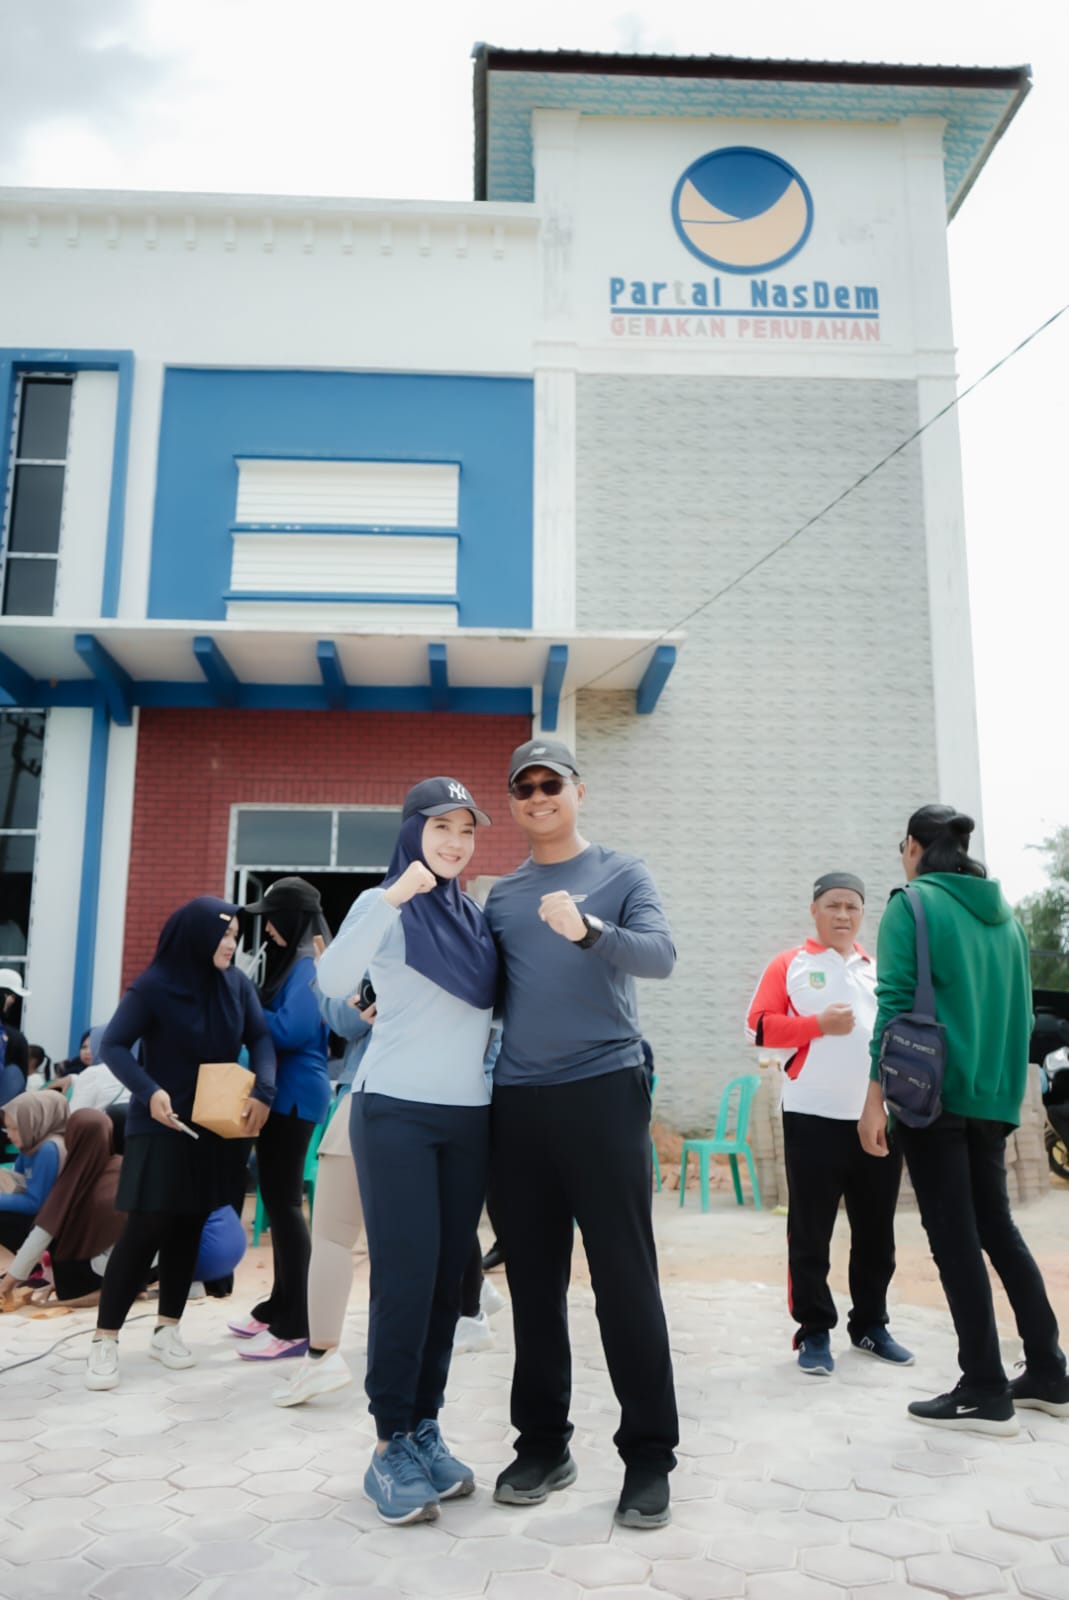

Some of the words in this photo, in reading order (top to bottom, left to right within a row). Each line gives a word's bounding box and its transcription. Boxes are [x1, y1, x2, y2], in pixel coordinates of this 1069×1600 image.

[751, 279, 879, 310] NasDem
[610, 316, 726, 338] GERAKAN
[738, 318, 880, 341] PERUBAHAN
[448, 783, 467, 800] NY
